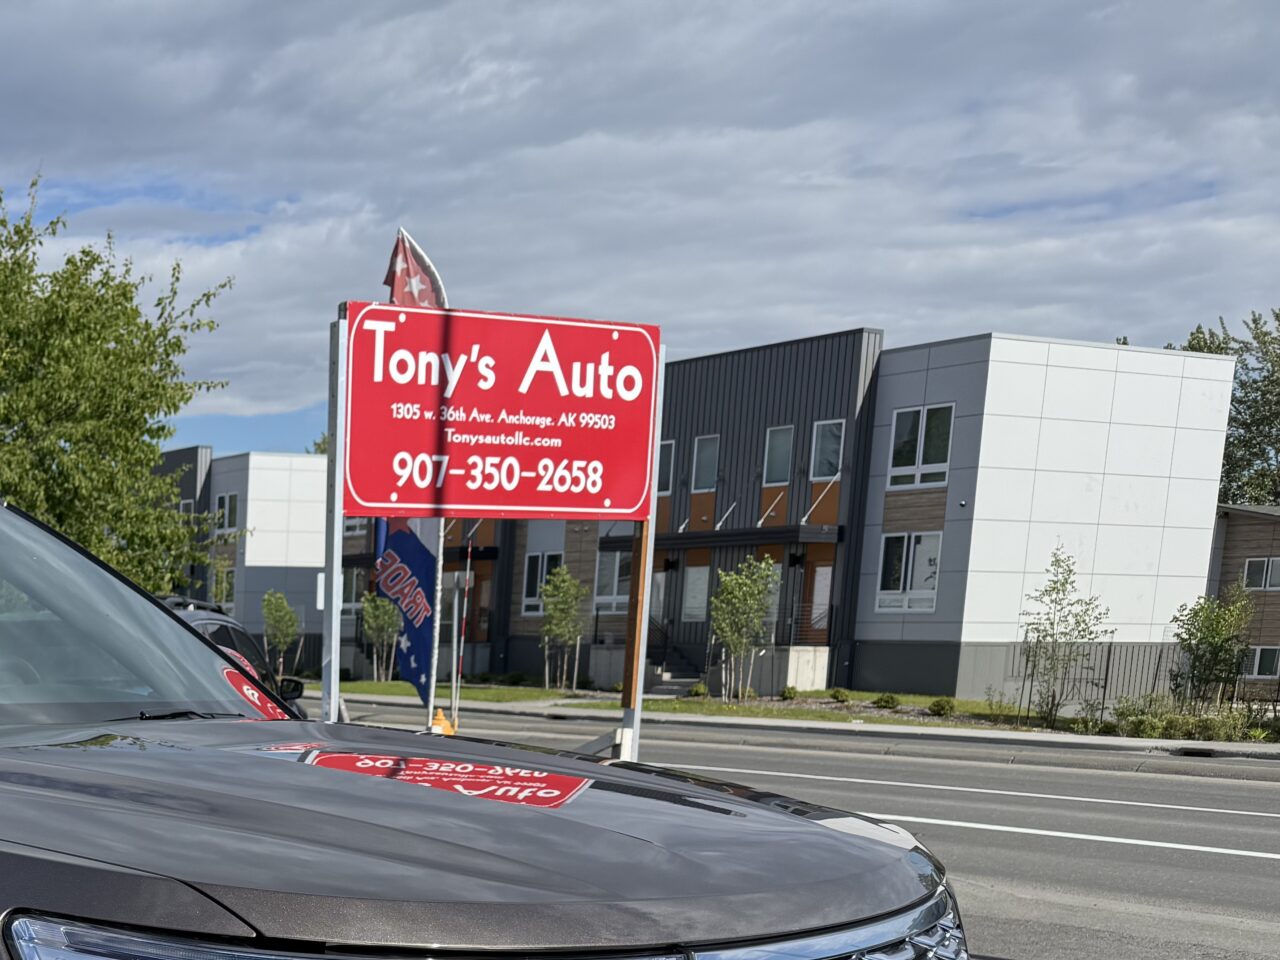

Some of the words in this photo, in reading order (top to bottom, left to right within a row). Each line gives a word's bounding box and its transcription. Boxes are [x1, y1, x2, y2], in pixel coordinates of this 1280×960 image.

[363, 320, 496, 398] Tony's
[518, 328, 643, 401] Auto
[391, 402, 420, 420] 1305
[440, 405, 466, 422] 36th
[468, 407, 494, 423] Ave.
[557, 412, 577, 427] AK
[579, 412, 615, 430] 99503
[444, 428, 562, 447] Tonysautollc.com
[392, 451, 603, 494] 907-350-2658
